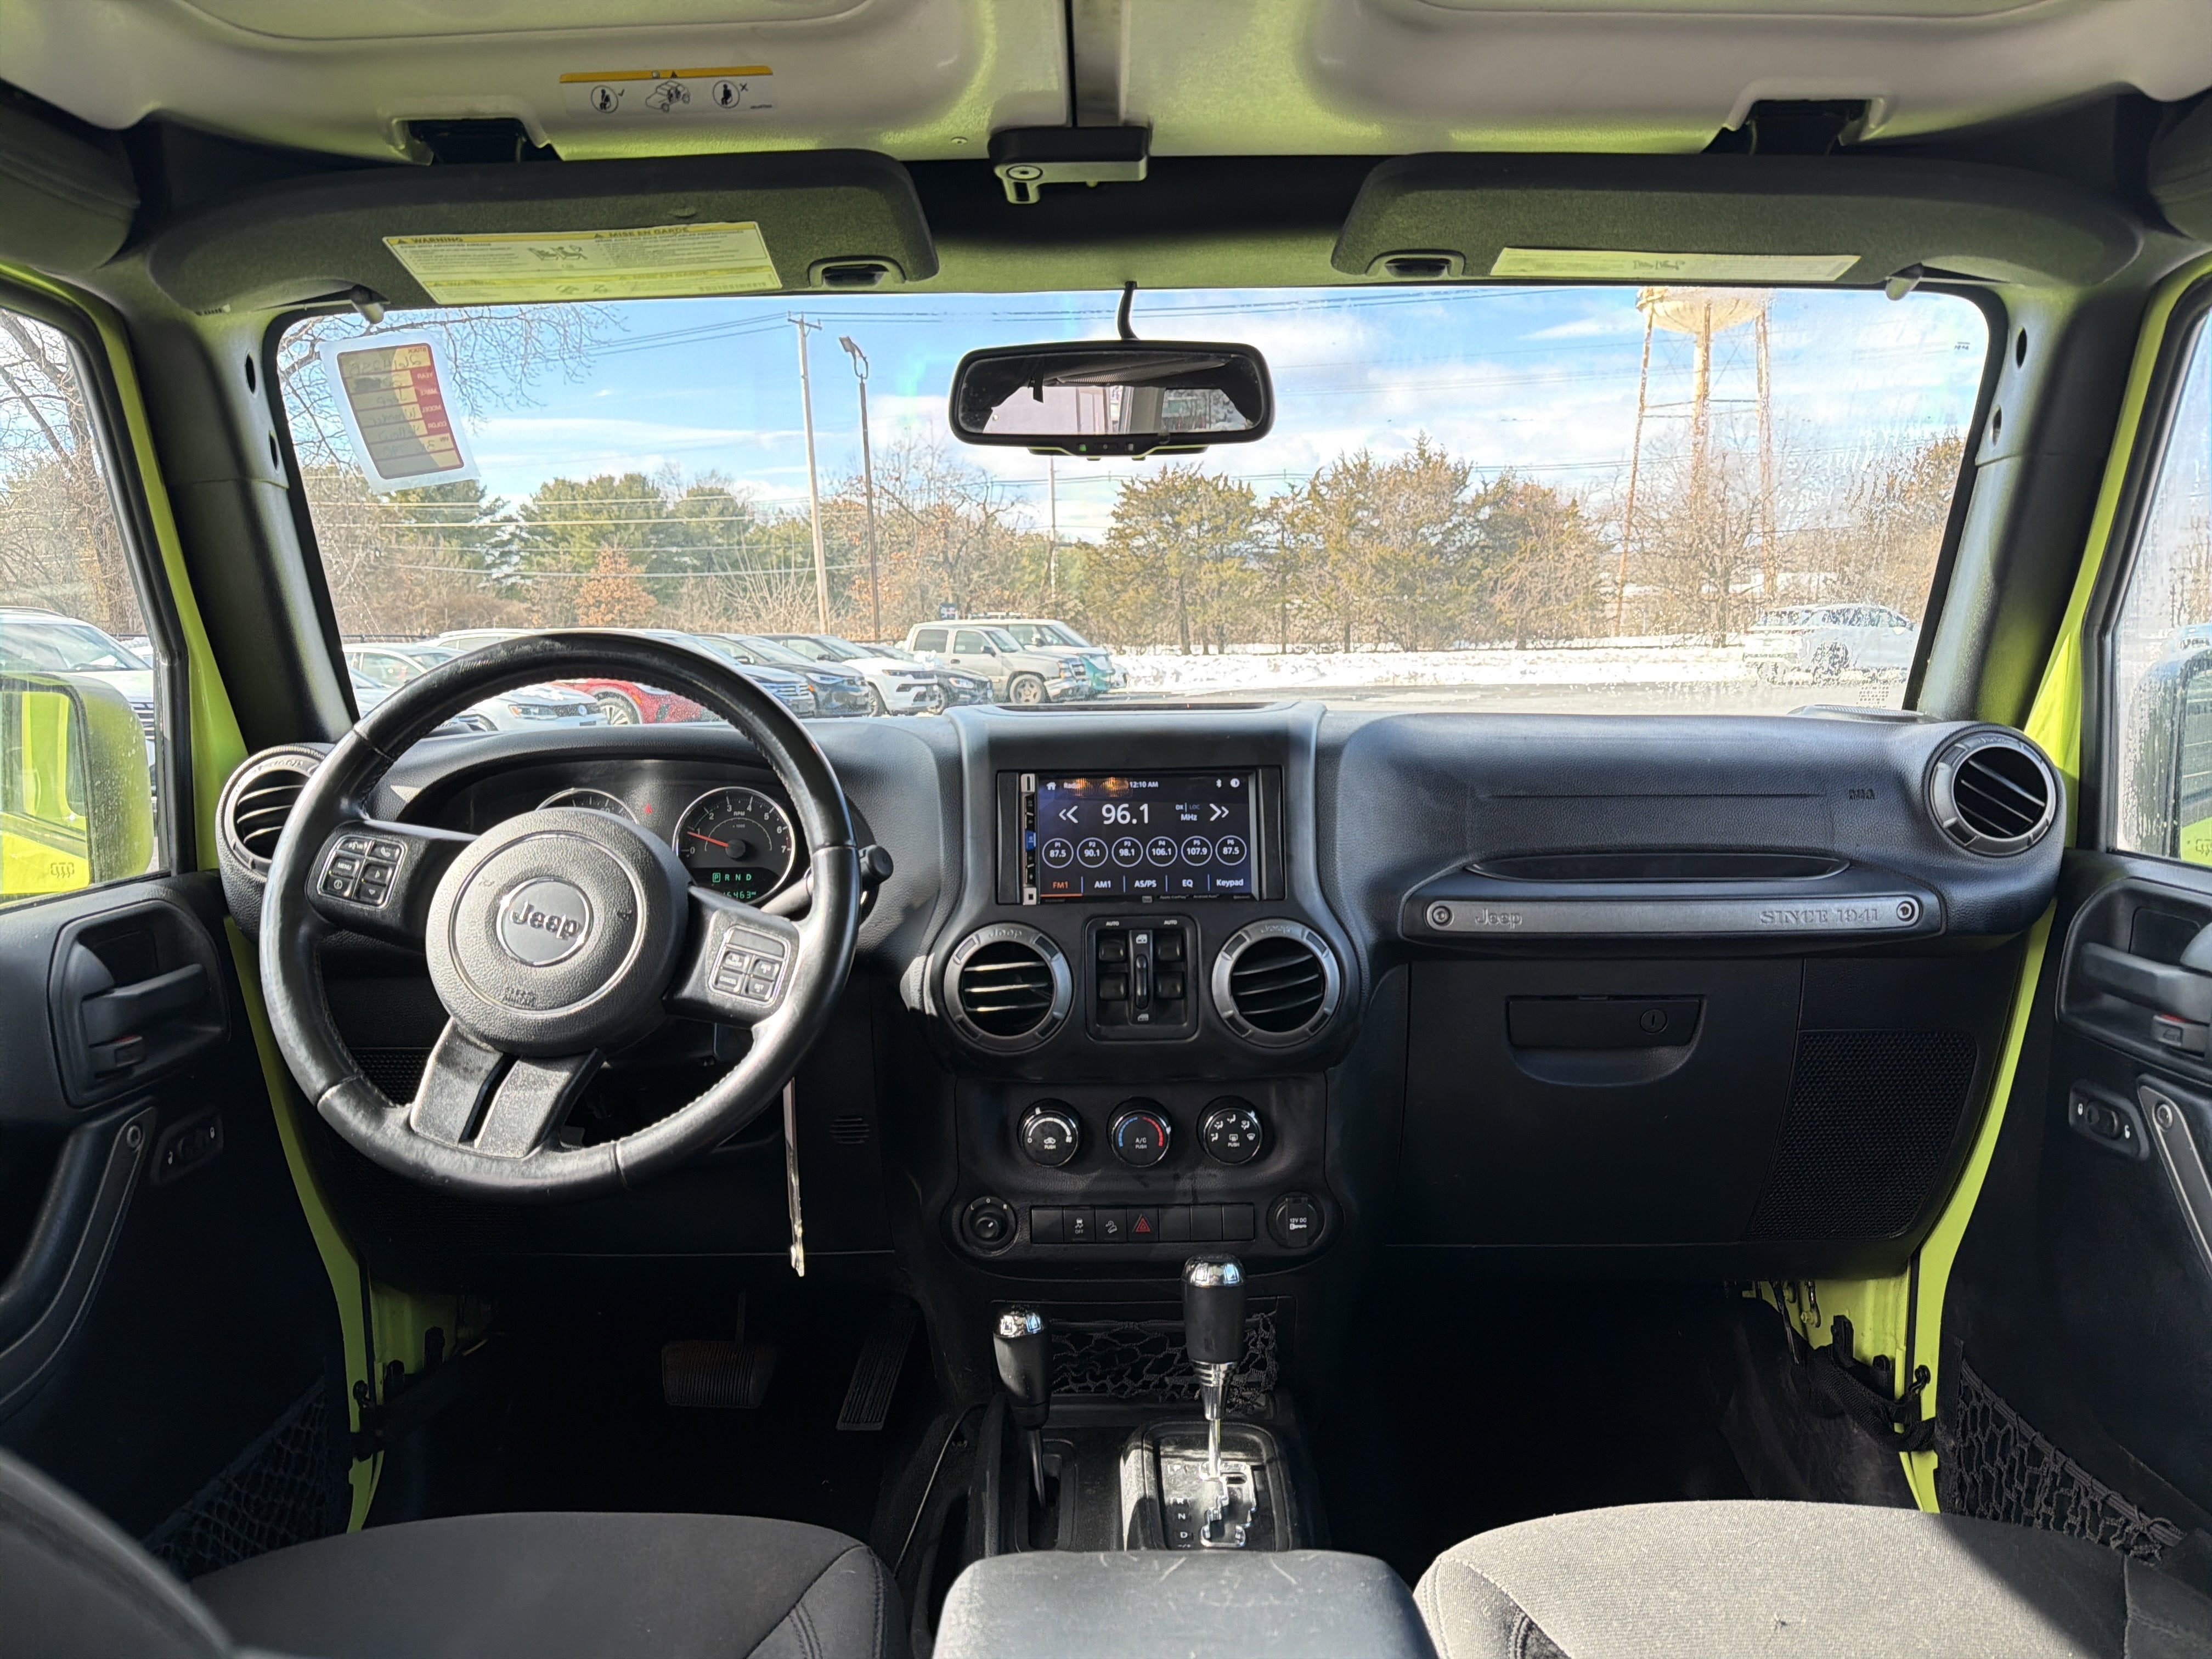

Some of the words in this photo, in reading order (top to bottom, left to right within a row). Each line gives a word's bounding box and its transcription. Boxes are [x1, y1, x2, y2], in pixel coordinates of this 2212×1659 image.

[1102, 803, 1150, 825] 96.1
[781, 845, 787, 854] 7
[1084, 849, 1100, 857] 90.1
[1152, 848, 1172, 856] 106.1
[1187, 847, 1207, 855] 107.9
[1222, 847, 1240, 855] 87.5
[337, 862, 352, 871] MENU
[1134, 879, 1157, 888] AS/PS
[1182, 880, 1194, 888] EQ
[1216, 879, 1244, 888] Keypad
[723, 891, 751, 900] 5463
[509, 900, 580, 941] Jeep
[1475, 909, 1522, 929] Jeep
[1759, 909, 1828, 924] SINCE
[1837, 908, 1878, 923] 1941
